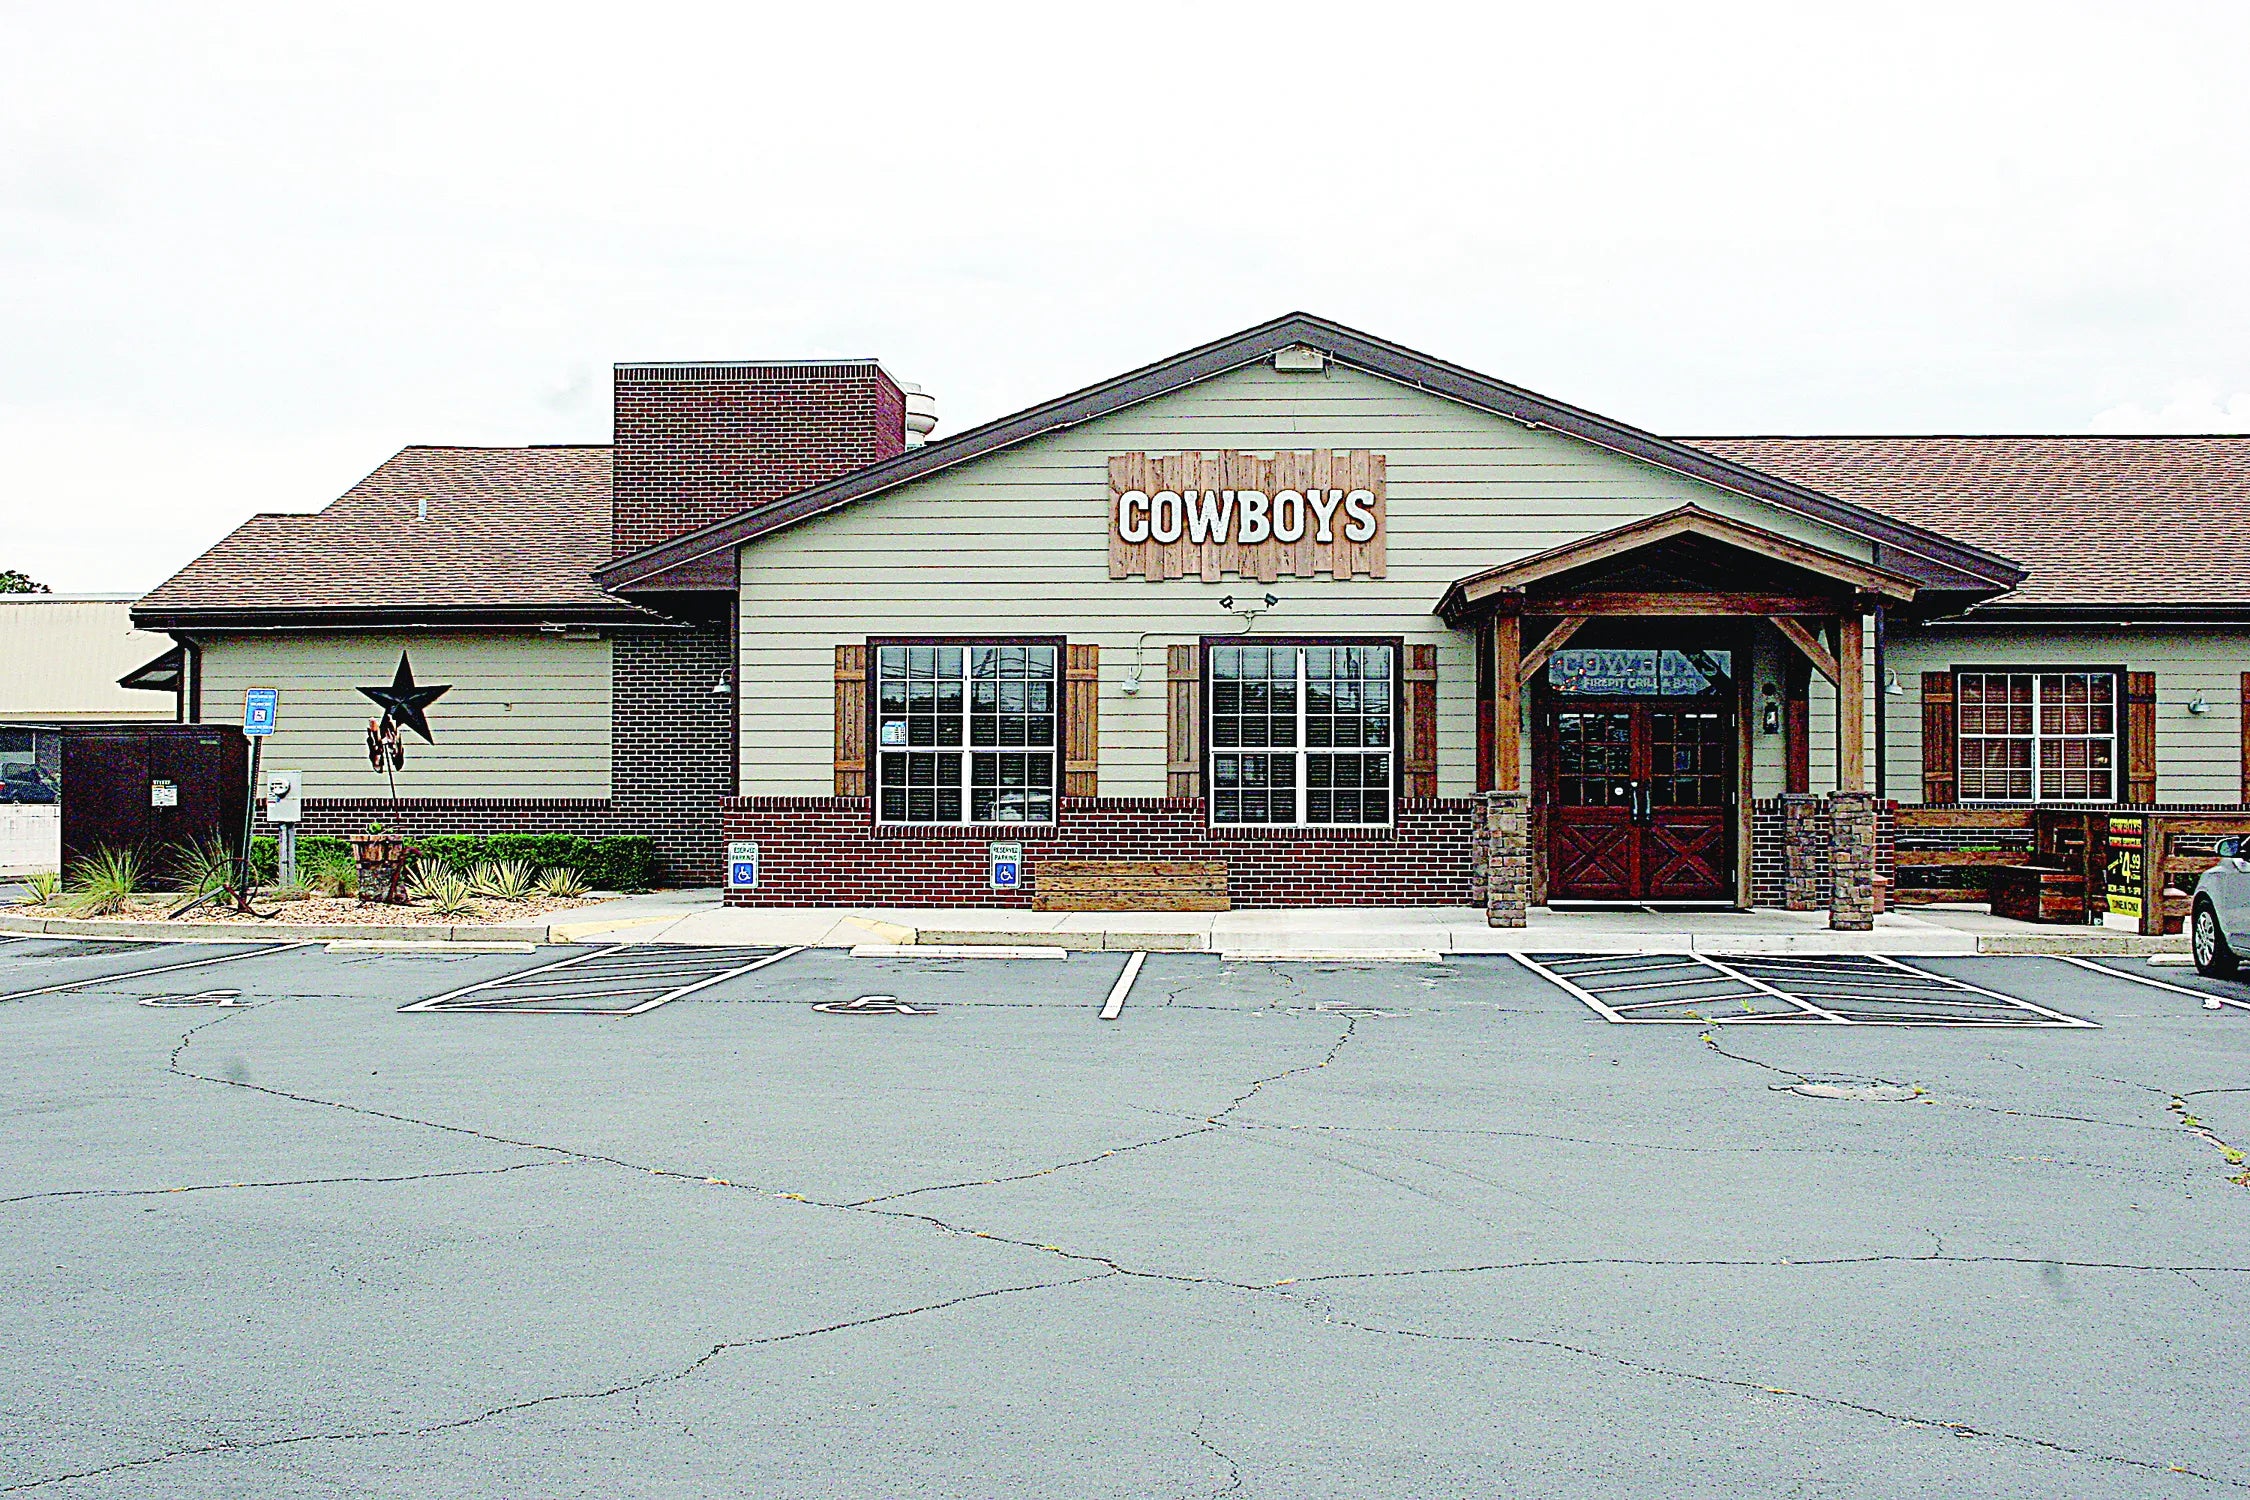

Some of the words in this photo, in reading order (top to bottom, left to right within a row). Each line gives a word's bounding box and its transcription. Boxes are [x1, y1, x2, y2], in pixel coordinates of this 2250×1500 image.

[1118, 489, 1377, 544] COWBOYS
[1583, 678, 1625, 688] FIREPIT
[1627, 678, 1658, 689] GRILL
[1673, 678, 1697, 689] BAR
